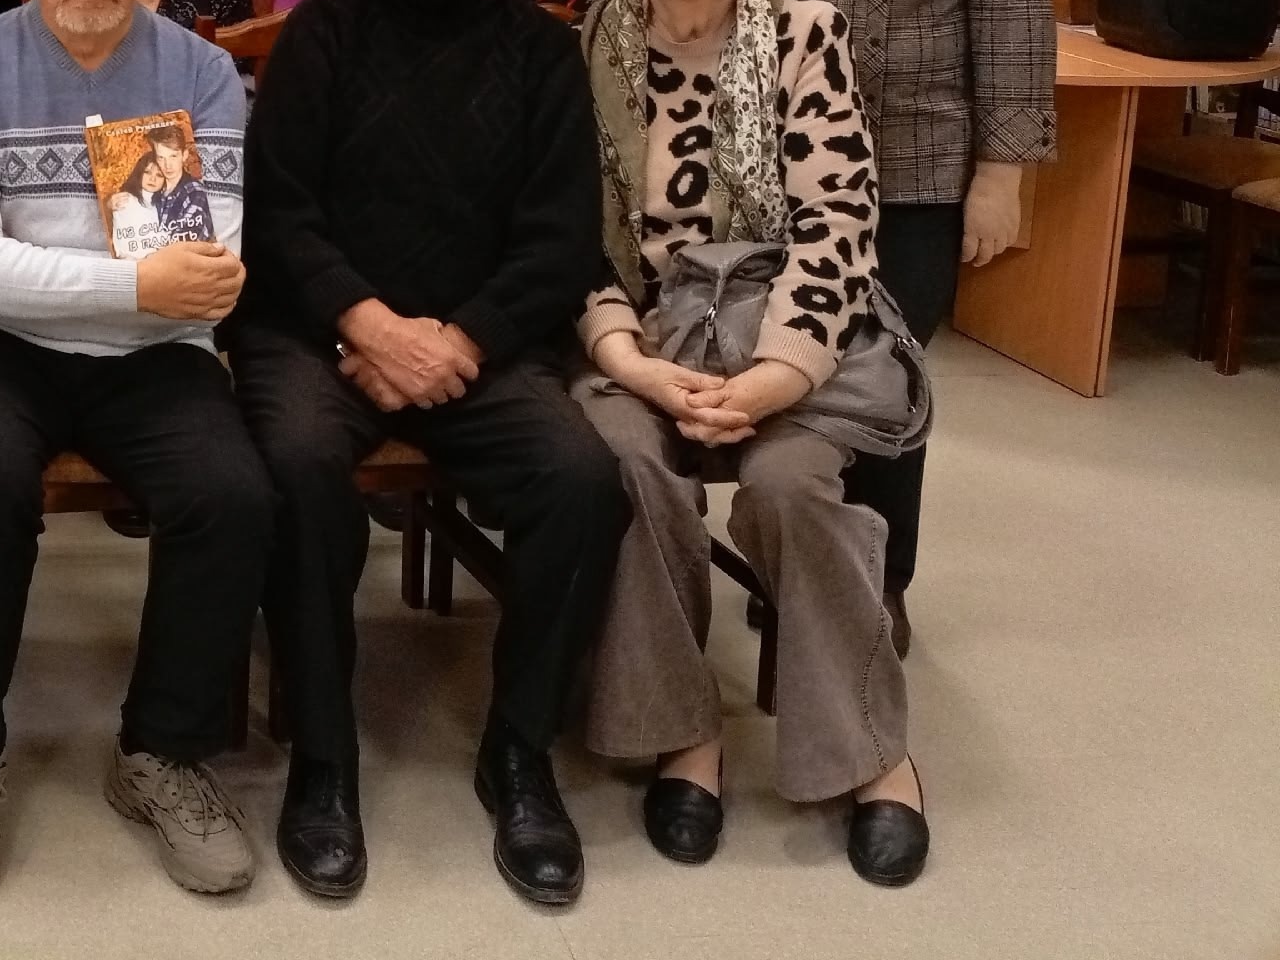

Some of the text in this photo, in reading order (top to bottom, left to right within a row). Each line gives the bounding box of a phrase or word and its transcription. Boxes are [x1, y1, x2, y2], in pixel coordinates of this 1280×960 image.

[116, 215, 204, 239] ИЗ СЧАСТЬЯ
[128, 230, 198, 252] В ПАМЯТЬ
